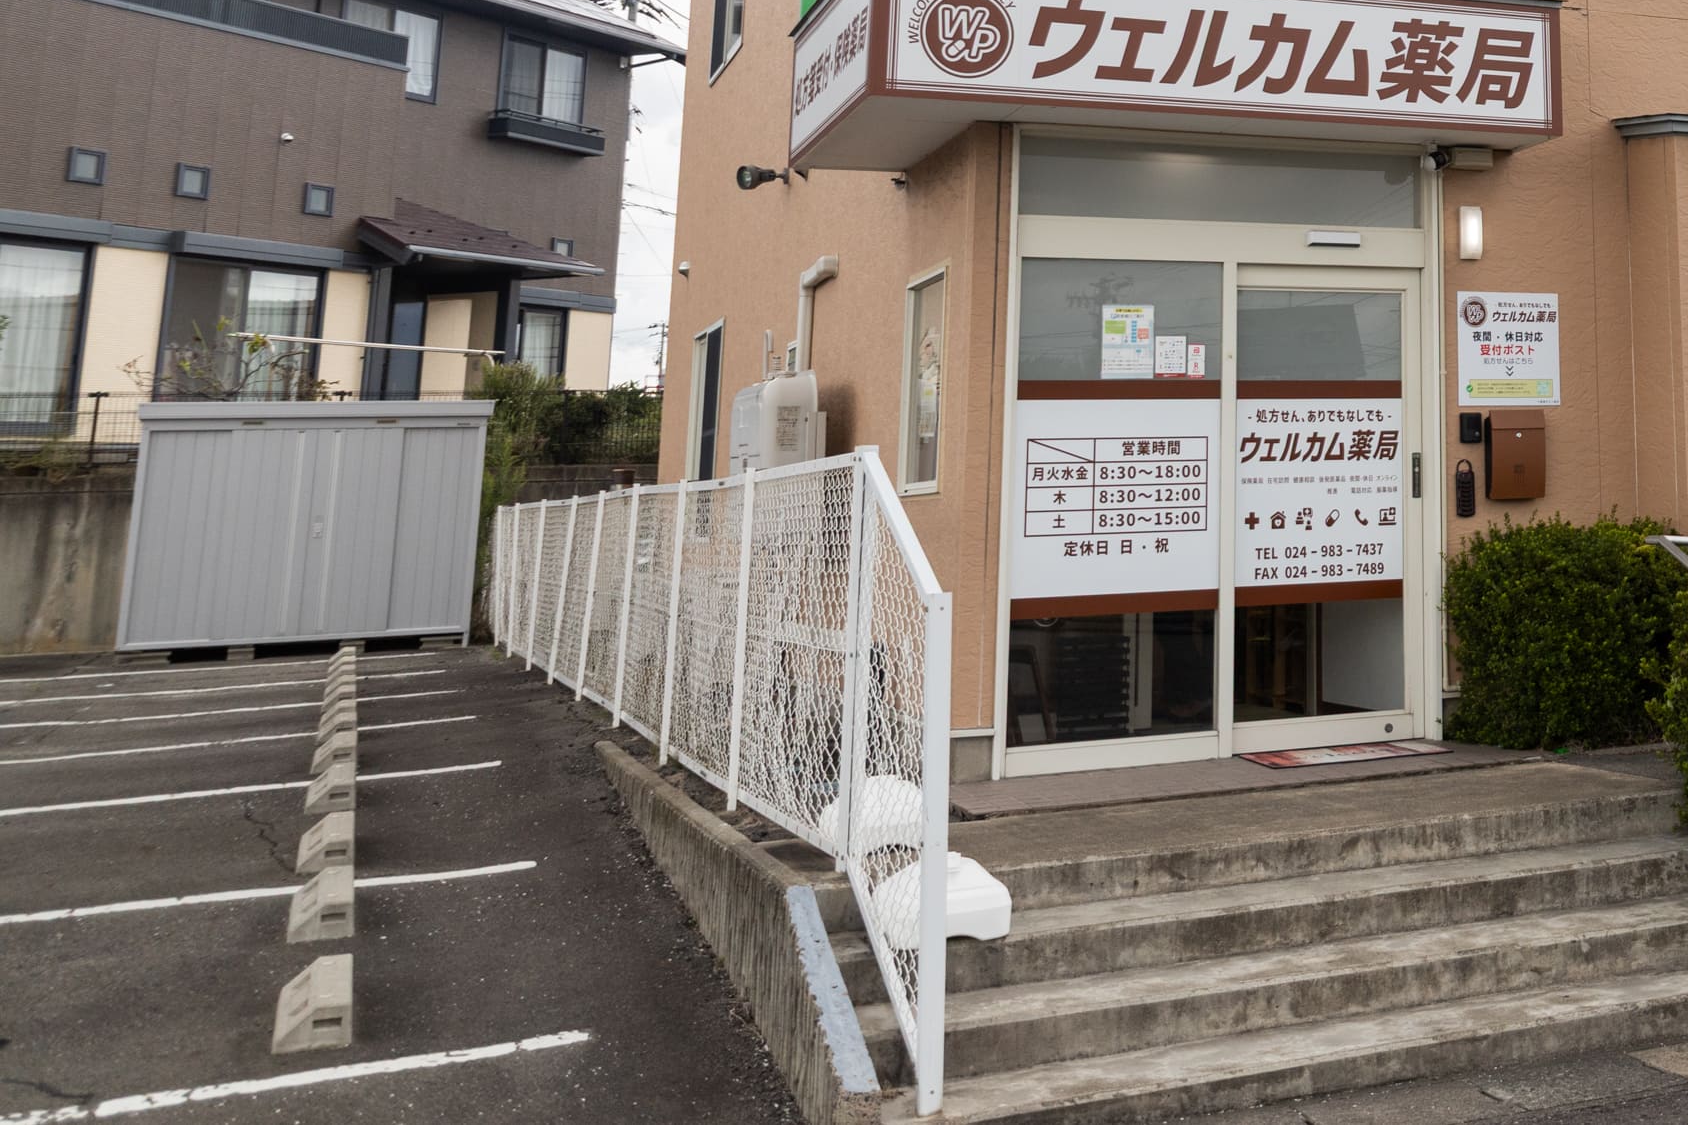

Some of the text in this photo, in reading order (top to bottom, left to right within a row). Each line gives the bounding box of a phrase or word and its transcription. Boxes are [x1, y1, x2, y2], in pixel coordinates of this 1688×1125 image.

[1492, 311, 1557, 323] ウェルカム薬局
[1480, 344, 1535, 356] 受付ポスト
[1122, 441, 1180, 456] 営業時間
[1240, 429, 1399, 463] ウェルカム薬局
[1032, 466, 1089, 481] 月火水金
[1053, 491, 1067, 505] 木
[1052, 515, 1066, 529] 土
[1064, 540, 1109, 557] 定休日
[1255, 547, 1278, 560] TEL
[1254, 566, 1278, 580] FAX
